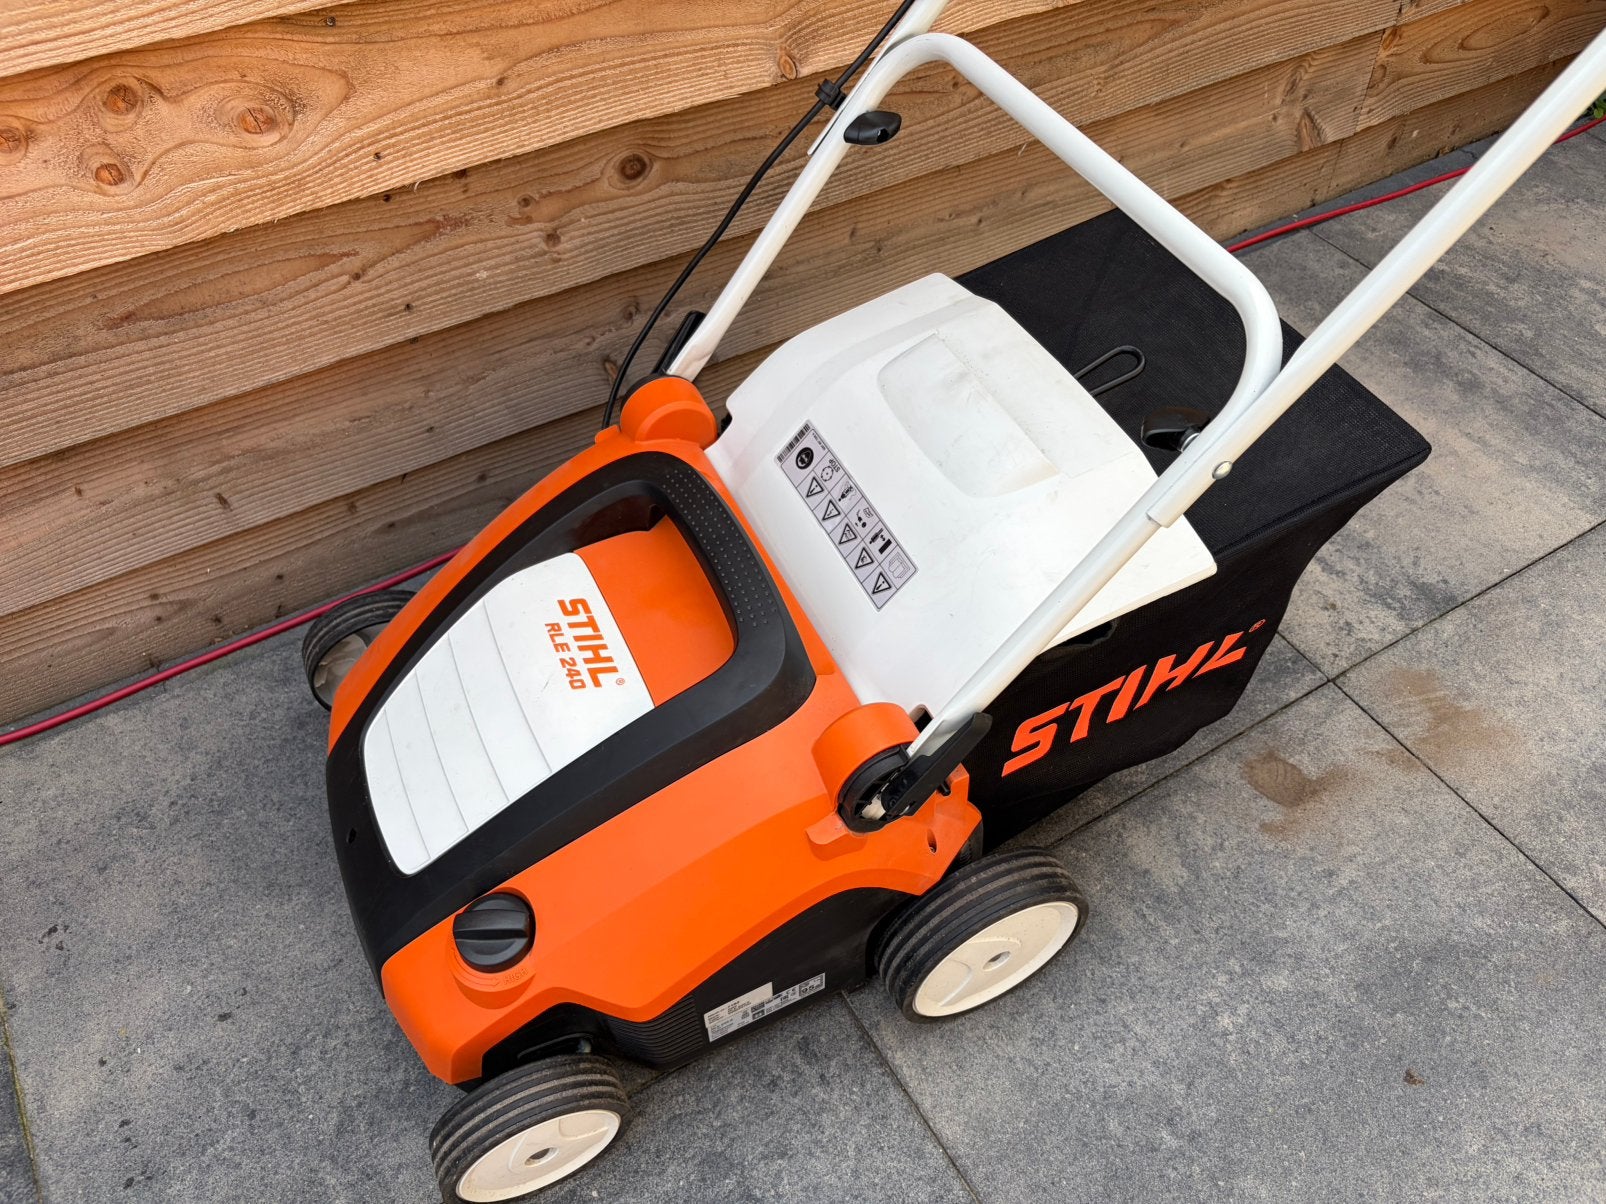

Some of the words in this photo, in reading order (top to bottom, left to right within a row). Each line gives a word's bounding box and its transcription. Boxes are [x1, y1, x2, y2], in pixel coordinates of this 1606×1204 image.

[828, 459, 841, 473] STOP
[545, 622, 571, 653] RLE
[559, 657, 587, 690] 240
[557, 598, 619, 688] STIHL
[1001, 631, 1247, 778] STIHL
